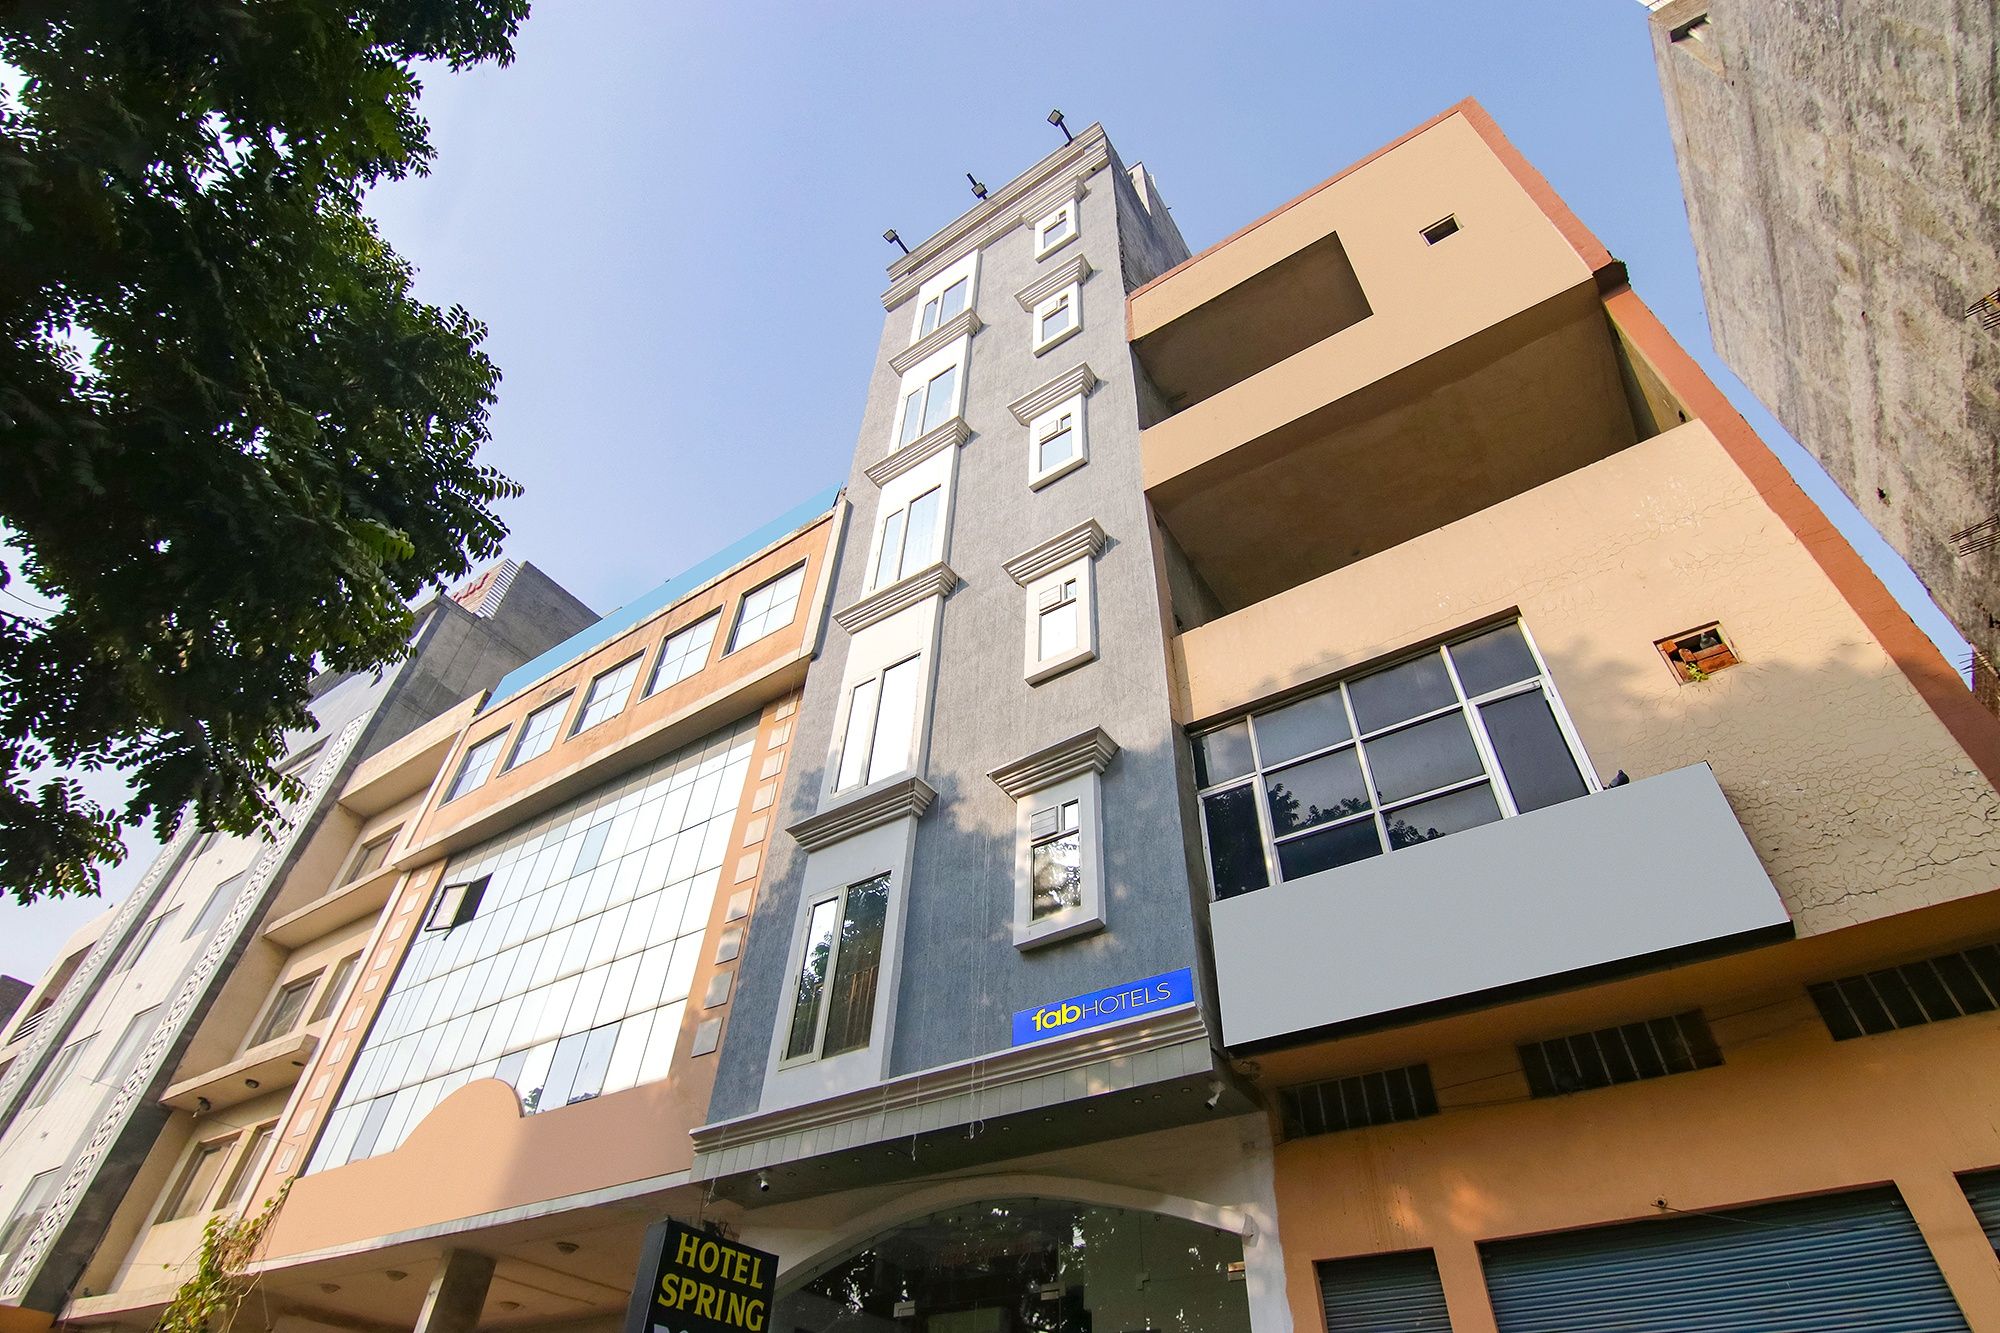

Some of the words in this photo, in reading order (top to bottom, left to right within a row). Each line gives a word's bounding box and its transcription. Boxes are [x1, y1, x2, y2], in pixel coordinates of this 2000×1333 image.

[1031, 982, 1172, 1032] fabHOTELS
[674, 1231, 764, 1290] HOTEL
[657, 1272, 765, 1332] SPRING
